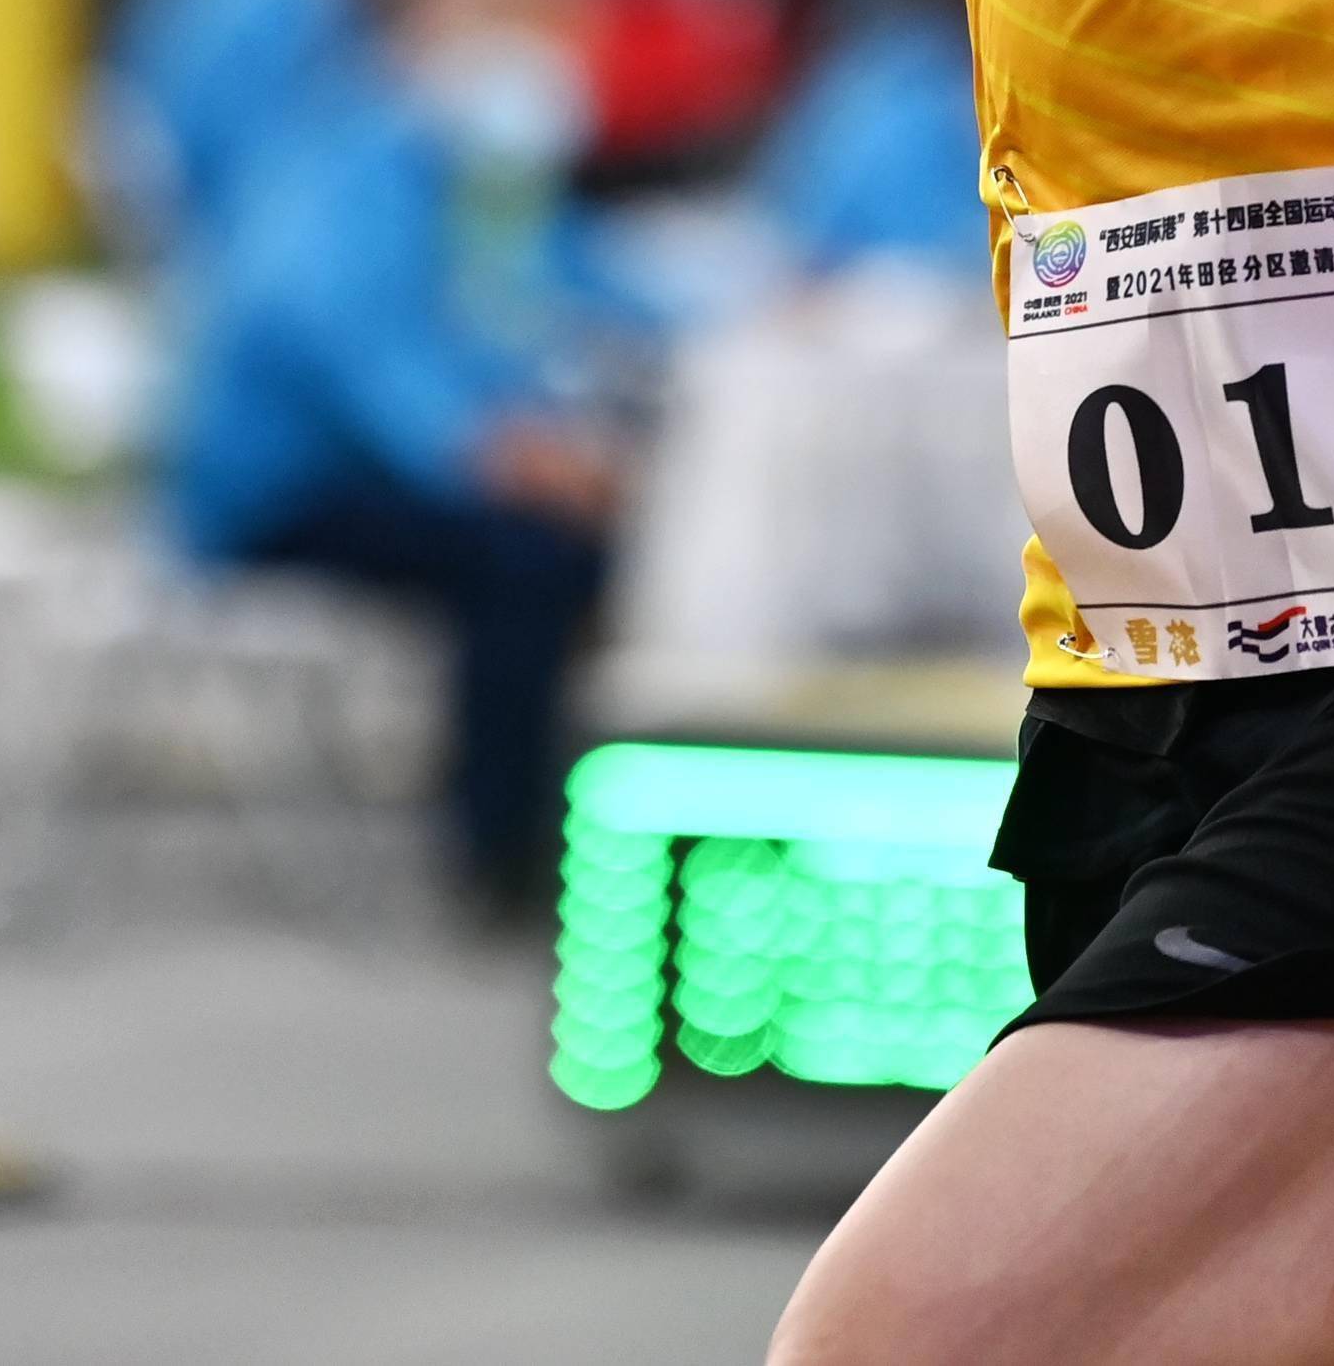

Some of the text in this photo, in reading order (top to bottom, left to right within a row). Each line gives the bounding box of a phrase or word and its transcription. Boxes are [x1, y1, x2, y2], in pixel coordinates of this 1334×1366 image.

[1064, 291, 1088, 305] 2021
[1023, 304, 1089, 322] SHAANXI CHINA
[1123, 617, 1202, 667] 雪花
[1296, 641, 1311, 653] DA
[1311, 638, 1331, 652] QIN
